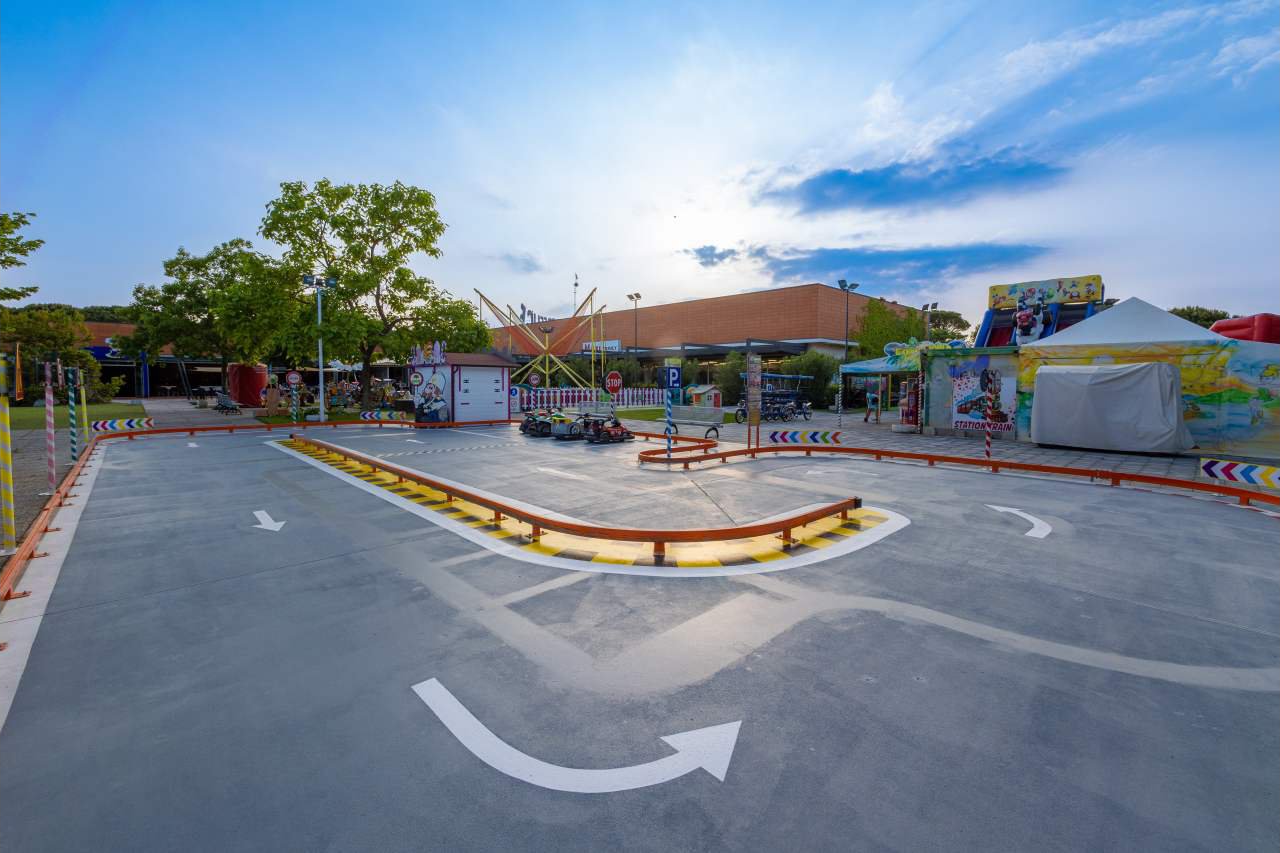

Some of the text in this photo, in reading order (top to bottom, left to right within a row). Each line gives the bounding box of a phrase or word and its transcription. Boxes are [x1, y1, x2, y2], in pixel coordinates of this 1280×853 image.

[669, 368, 679, 386] P
[607, 378, 621, 388] STOP
[954, 421, 1013, 431] STATION RAIN
